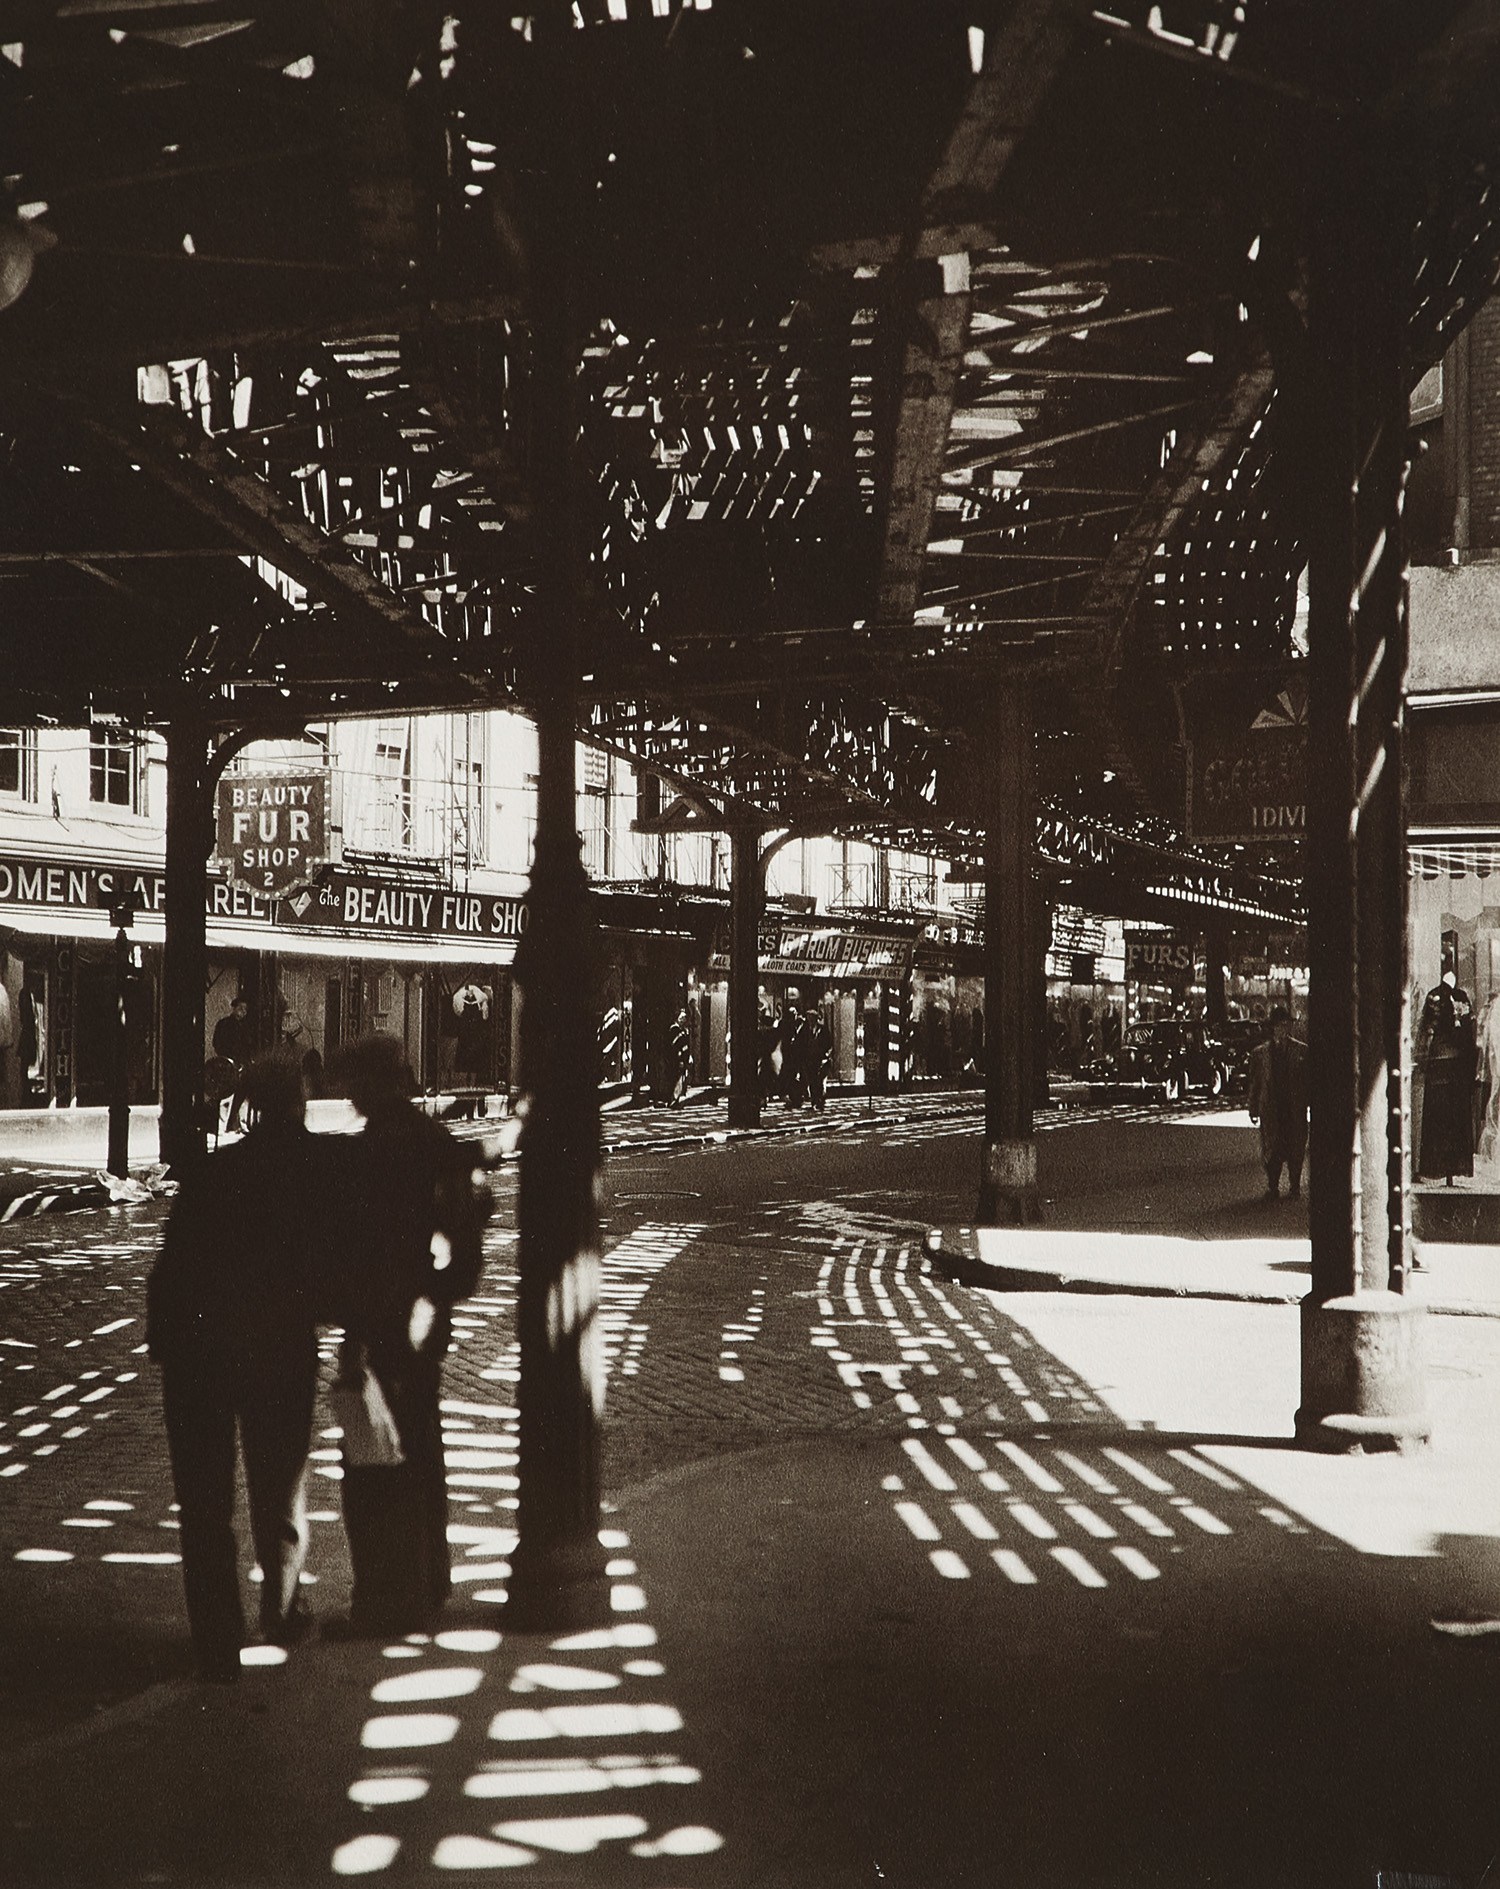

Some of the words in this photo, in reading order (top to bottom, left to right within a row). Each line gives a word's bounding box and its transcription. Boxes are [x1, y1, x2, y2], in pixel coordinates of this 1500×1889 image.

[232, 785, 313, 807] BEAUTY
[232, 809, 311, 844] FUR
[243, 847, 300, 868] SHOP
[264, 871, 274, 887] 2
[344, 886, 433, 928] BEAUTY
[442, 896, 482, 932] FUR
[797, 933, 840, 960] FROM
[1126, 944, 1190, 970] FURS
[786, 961, 806, 972] COATS
